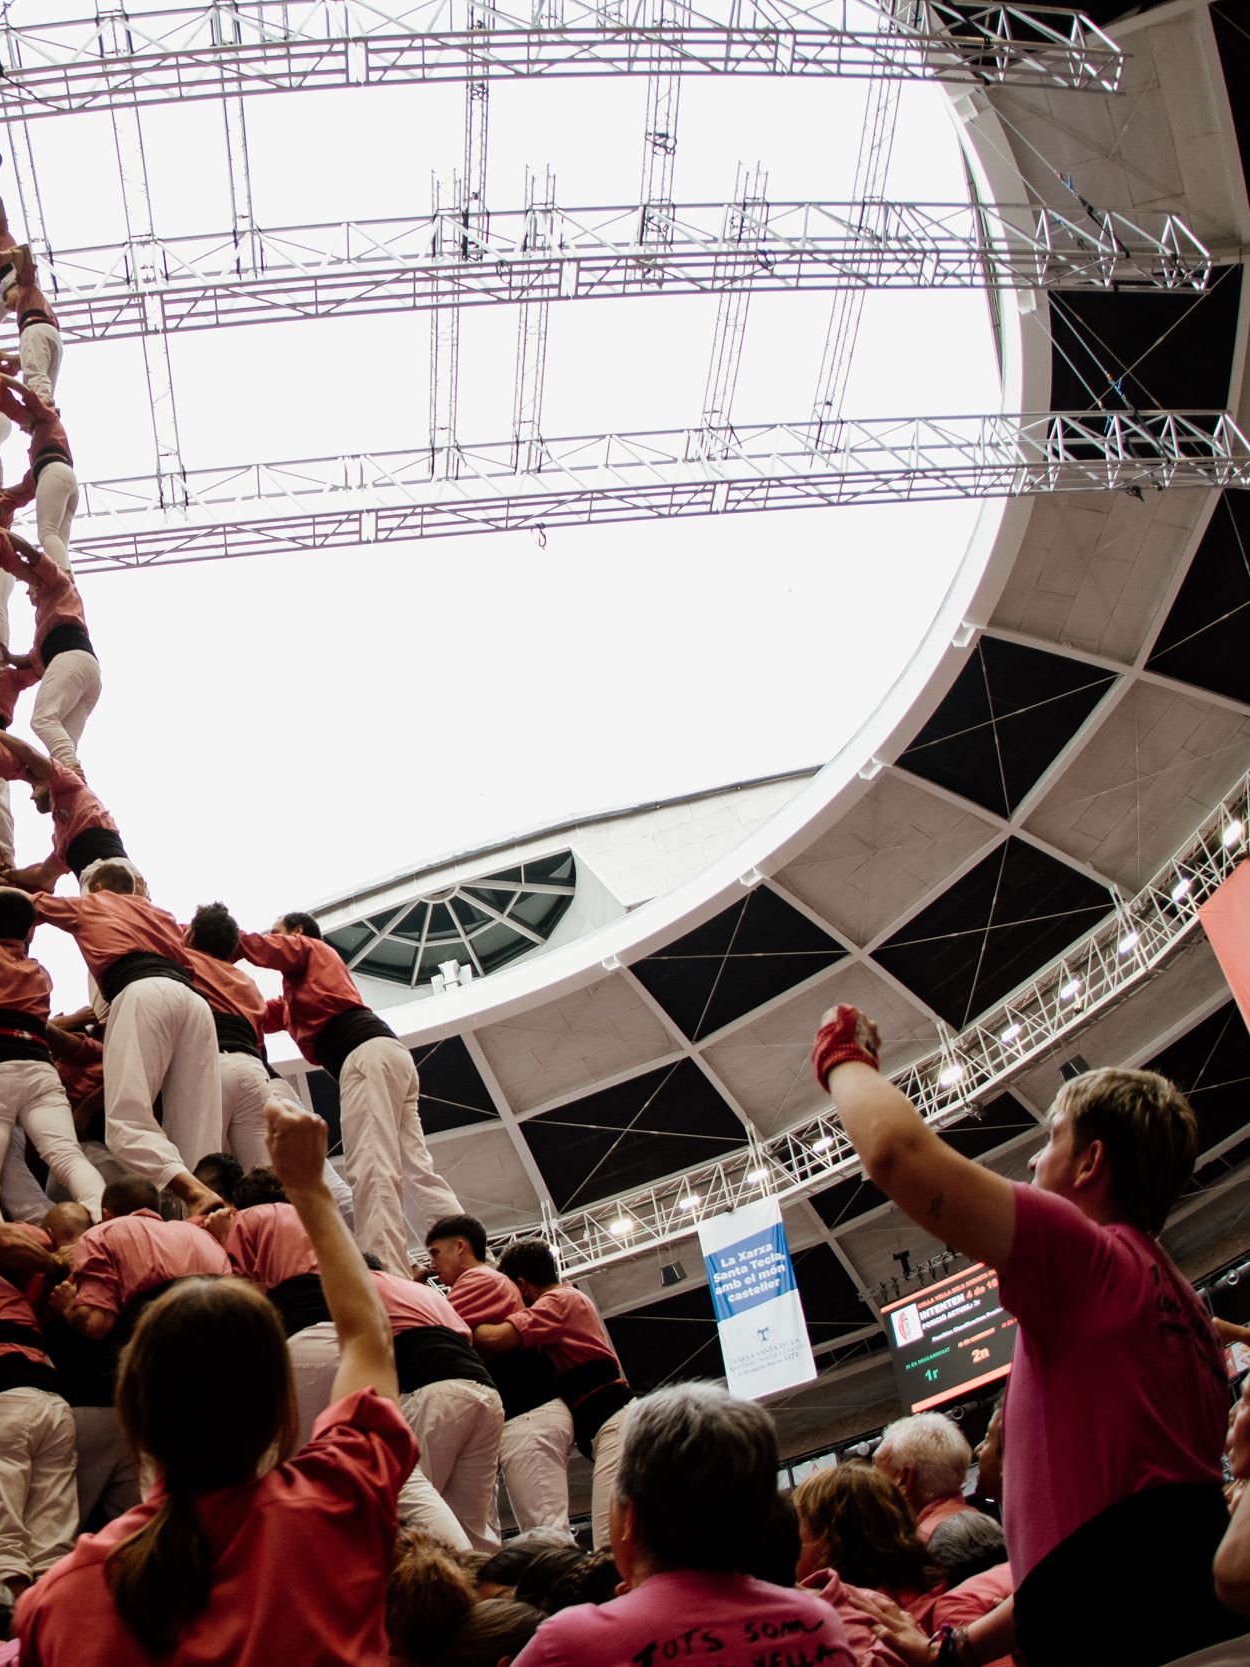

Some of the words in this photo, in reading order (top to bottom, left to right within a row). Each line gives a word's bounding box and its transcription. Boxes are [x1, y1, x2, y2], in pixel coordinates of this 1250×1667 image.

[720, 1256, 736, 1268] La
[737, 1243, 773, 1262] Xarxa
[713, 1265, 748, 1283] Santa
[715, 1279, 742, 1295] amb
[744, 1273, 756, 1284] el
[758, 1264, 786, 1280] món
[727, 1278, 780, 1303] casteller
[919, 1292, 965, 1320] INTENTEN
[966, 1290, 973, 1300] 4
[973, 1285, 986, 1297] de
[986, 1278, 999, 1289] 10
[918, 1346, 951, 1365] DESCARREGAT
[971, 1348, 990, 1364] 2n
[925, 1368, 939, 1381] 1r
[633, 1626, 725, 1667] TOTS
